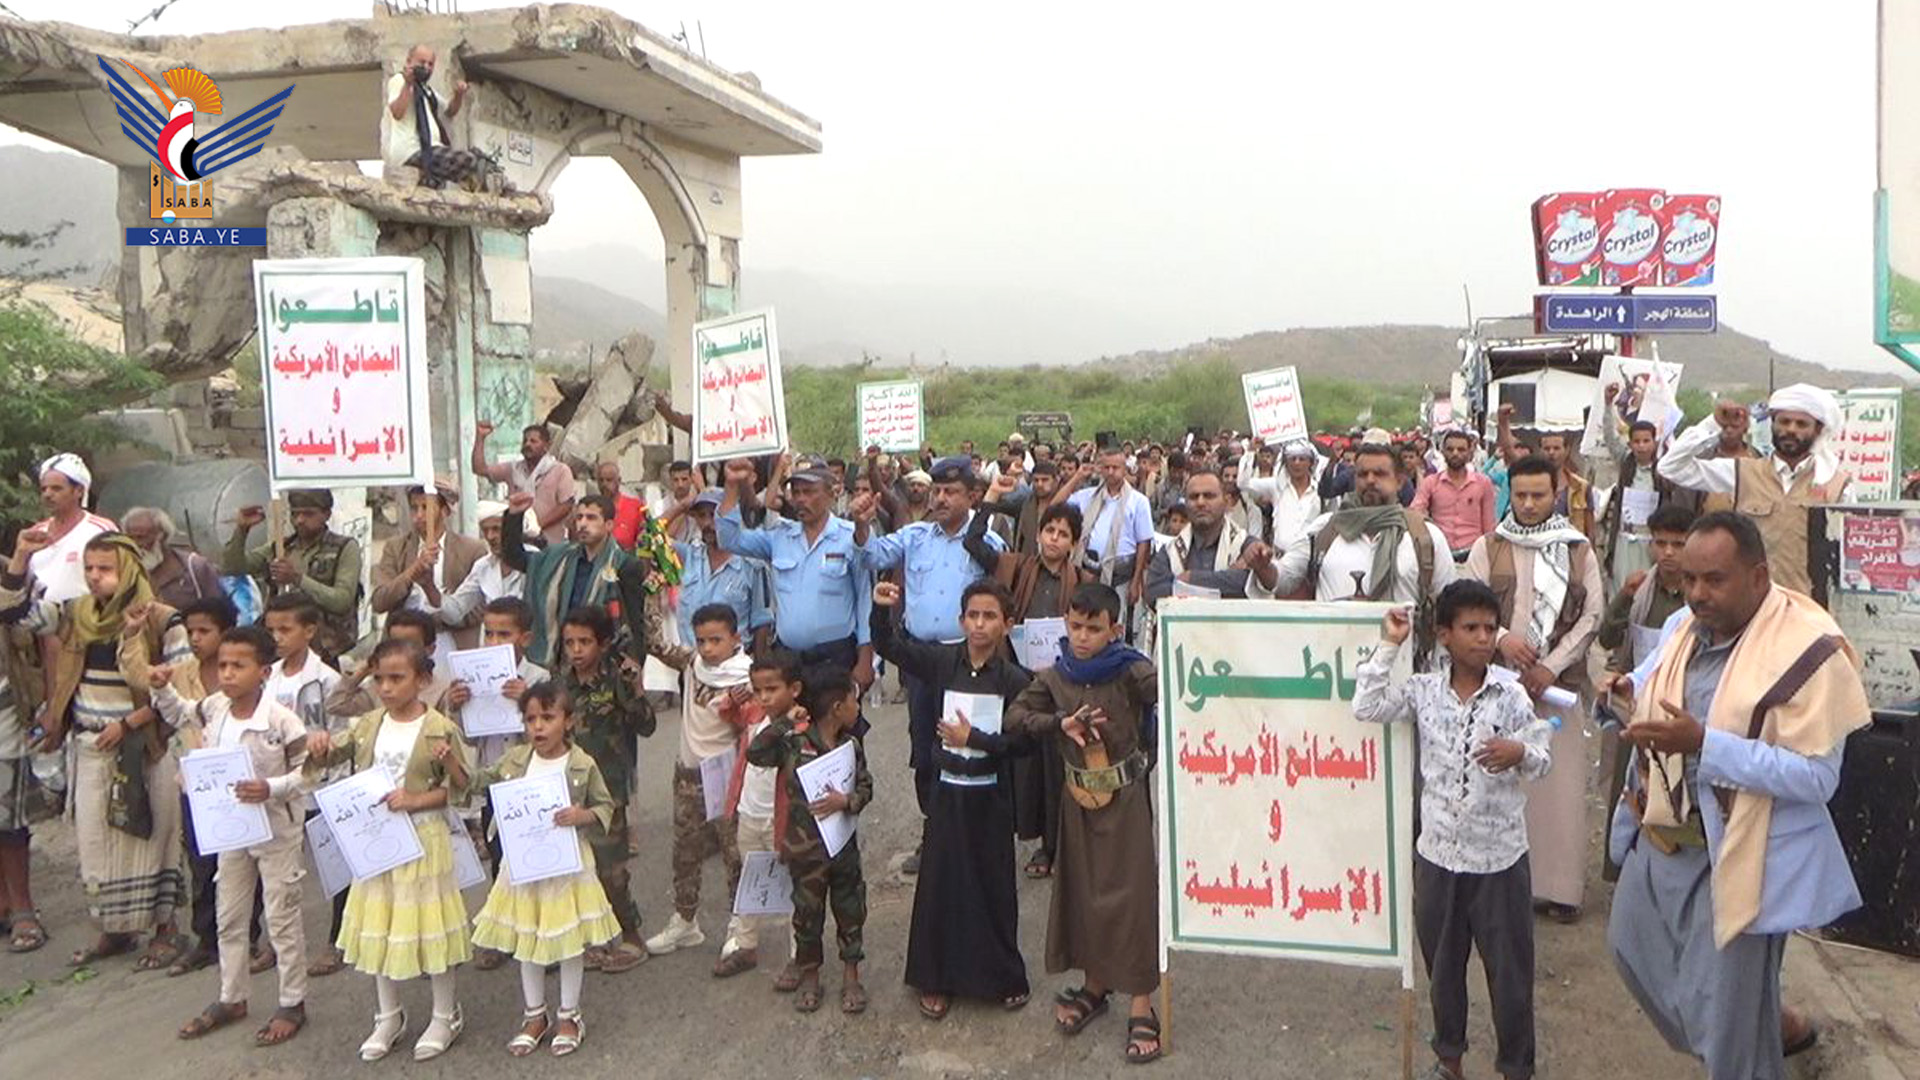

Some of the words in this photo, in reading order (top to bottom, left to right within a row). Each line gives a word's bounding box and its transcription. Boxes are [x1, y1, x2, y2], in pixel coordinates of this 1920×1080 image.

[1547, 225, 1597, 255] Crystal
[1603, 223, 1655, 255] Crystal
[1663, 226, 1711, 254] Crystal
[270, 289, 399, 332] قاطعوا
[1555, 304, 1612, 322] الراهدة
[1674, 306, 1710, 318] منطقة
[273, 340, 339, 379] الأمريكية
[343, 344, 400, 378] البضائع
[332, 387, 341, 413] و
[1859, 403, 1894, 422] الله
[279, 424, 405, 462] الإسرائيلية
[1850, 430, 1892, 445] الموت
[1849, 450, 1890, 465] الموت
[1179, 723, 1279, 785] الأمريكية
[1285, 731, 1376, 789] البضائع
[503, 801, 531, 821] الله
[1268, 800, 1281, 842] و
[1184, 860, 1381, 924] الإسرائيلية
